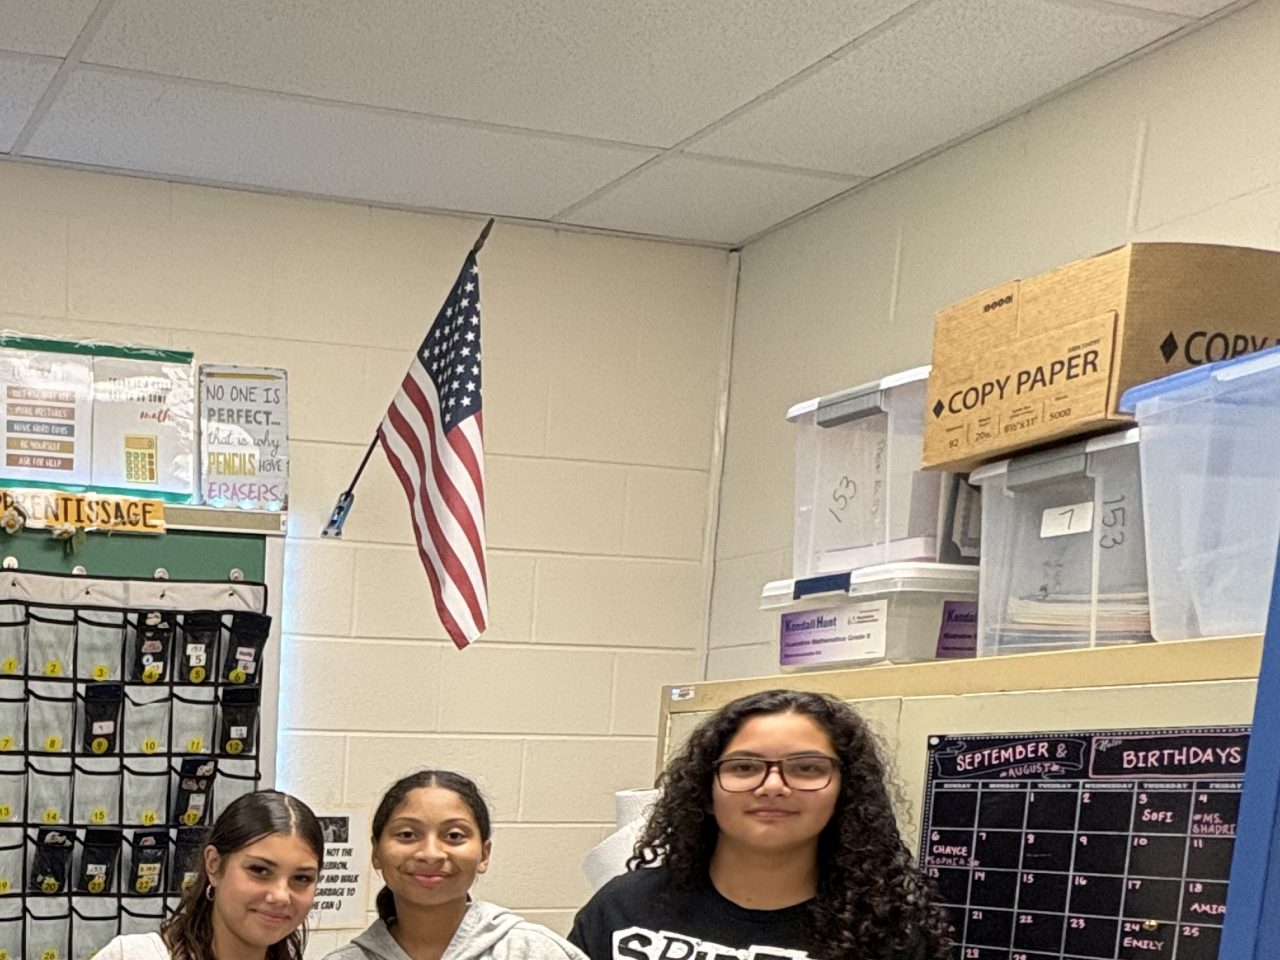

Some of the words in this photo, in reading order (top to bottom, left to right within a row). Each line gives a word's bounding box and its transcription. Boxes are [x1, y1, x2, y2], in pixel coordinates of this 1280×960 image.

[947, 374, 1011, 415] COPY
[1016, 349, 1100, 396] PAPER
[206, 385, 225, 401] NO
[230, 385, 258, 402] ONE
[263, 387, 281, 404] IS
[1048, 407, 1072, 422] 5000
[207, 427, 232, 447] that
[237, 431, 248, 446] is
[253, 430, 281, 457] why
[207, 452, 256, 476] PENCILS
[1099, 494, 1126, 550] 153
[784, 617, 816, 633] Kendall
[817, 615, 838, 630] Hunt
[145, 740, 157, 750] 10
[228, 742, 241, 751] 12
[955, 741, 1049, 772] SEPTEMBER
[1122, 746, 1242, 769] BIRTHDAYS
[1138, 793, 1148, 805] 3
[94, 811, 106, 820] 15
[186, 813, 198, 822] 17
[931, 831, 941, 841] 6
[1133, 837, 1148, 847] 10
[1193, 839, 1203, 848] 11
[325, 847, 341, 857] NOT
[341, 847, 354, 857] THE
[325, 874, 339, 883] AND
[340, 874, 360, 883] WALK
[1022, 874, 1035, 884] 15
[1127, 880, 1142, 890] 17
[346, 887, 356, 897] TO
[320, 901, 335, 910] CAN
[1070, 918, 1086, 929] 23
[1123, 922, 1141, 932] 24
[1182, 926, 1200, 937] 25
[1122, 936, 1165, 951] EMILY
